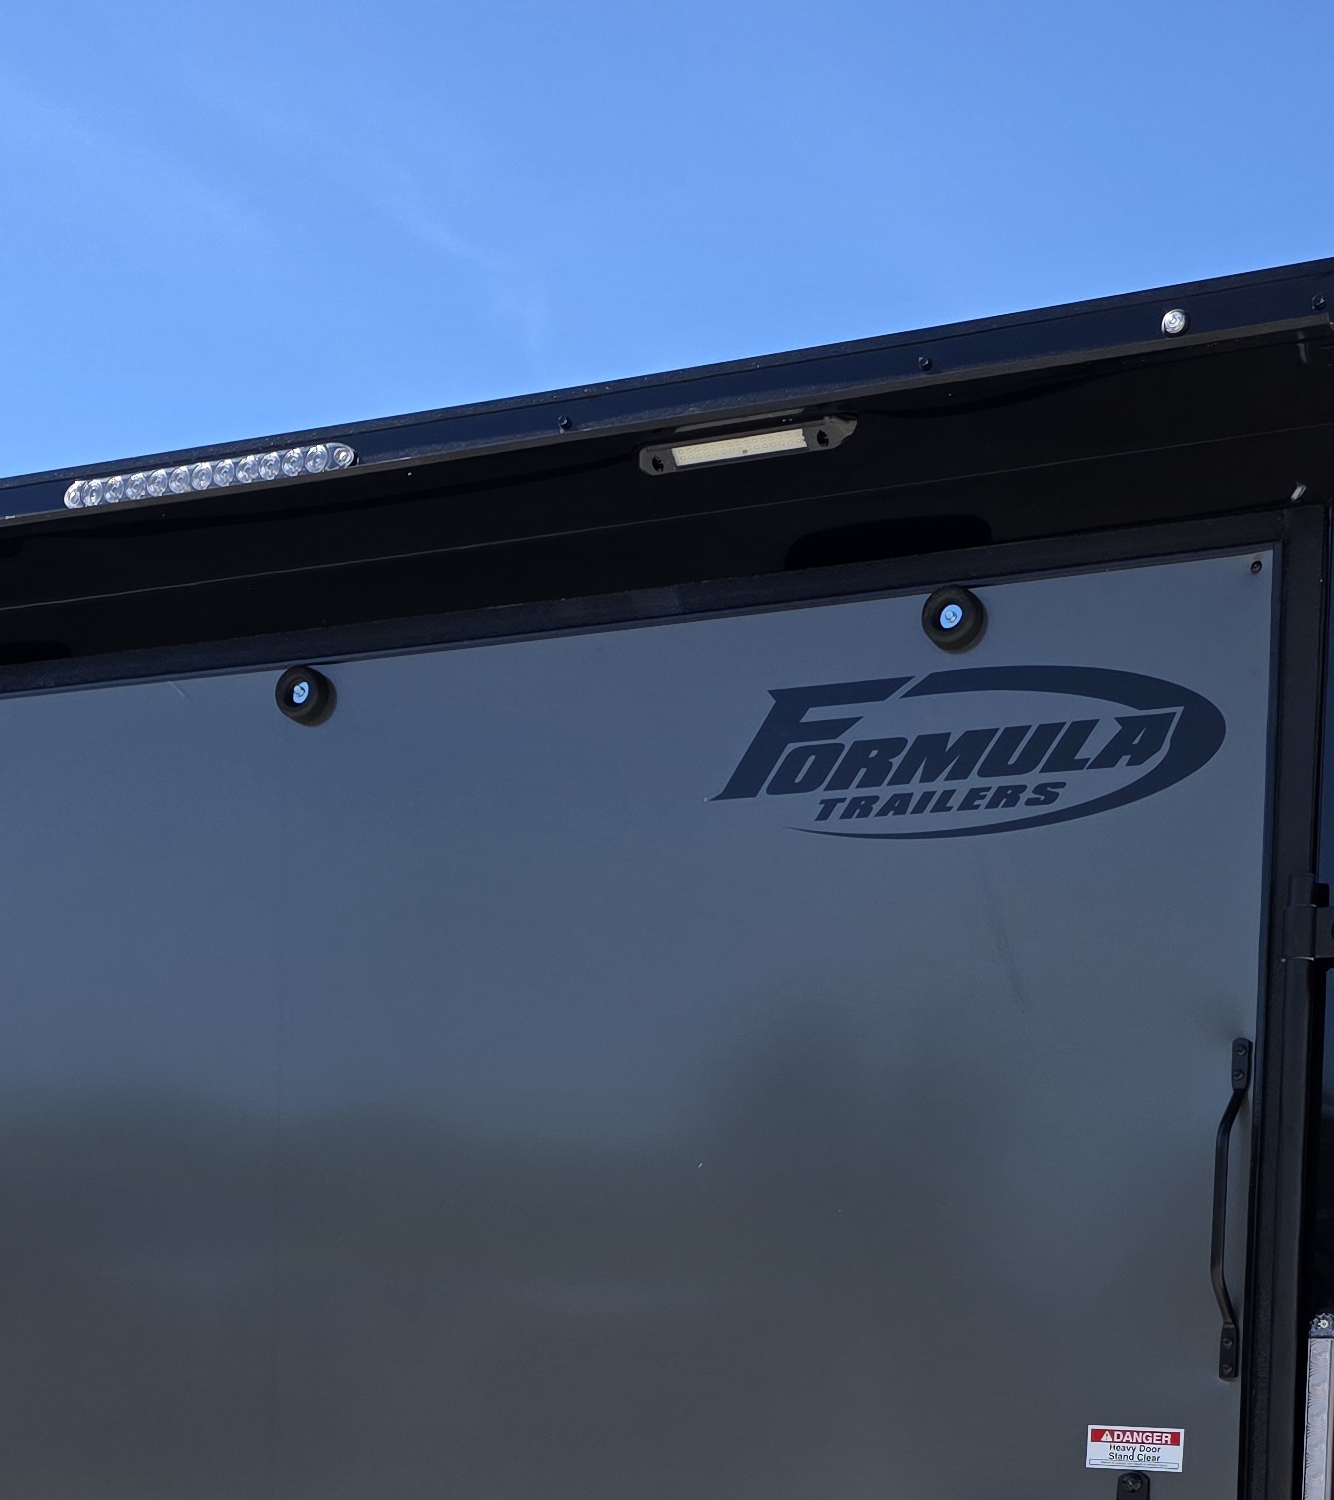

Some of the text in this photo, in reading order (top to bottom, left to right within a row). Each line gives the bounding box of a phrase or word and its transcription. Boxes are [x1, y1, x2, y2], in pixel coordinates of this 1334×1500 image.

[705, 675, 1178, 801] FORMULA
[814, 780, 1067, 822] TRAILERS
[1113, 1430, 1172, 1445] DANGER
[1109, 1443, 1162, 1455] Heavy Door
[1108, 1452, 1161, 1463] Stand Clear
